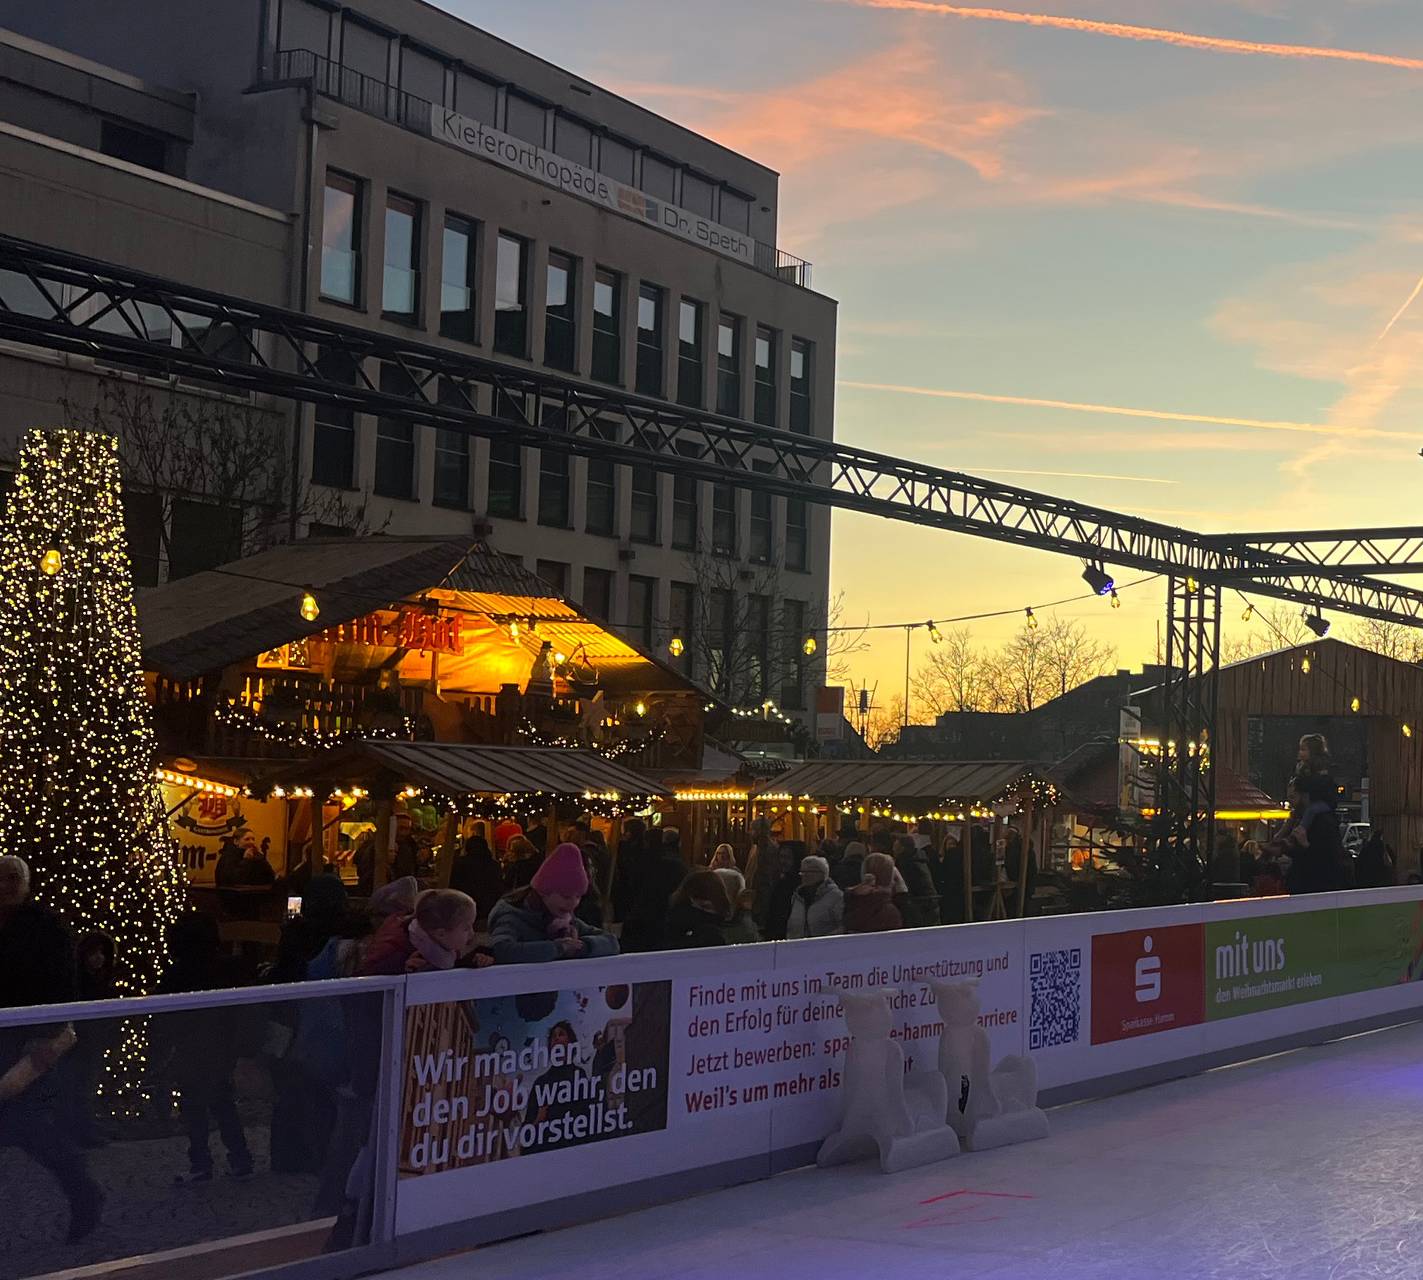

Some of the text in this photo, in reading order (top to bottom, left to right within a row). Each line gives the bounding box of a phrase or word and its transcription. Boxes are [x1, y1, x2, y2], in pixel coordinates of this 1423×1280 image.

[443, 110, 748, 257] Kieferorthopäde Dr. Speth
[1215, 931, 1285, 979] mit uns
[689, 952, 1009, 1008] Finde mit uns im Team die Unterstützung und
[1216, 987, 1231, 1003] den
[1232, 977, 1295, 1000] Weihnachtsmarkt
[688, 1001, 844, 1038] den Erfolg für deine
[412, 1037, 583, 1087] Wir machen
[686, 1052, 729, 1076] Jetzt
[733, 1040, 816, 1069] bewerben:
[412, 1063, 657, 1128] den Job wahr, den
[685, 1067, 841, 1114] Weil's um mehr als
[410, 1101, 634, 1169] du dir vorstellst.
